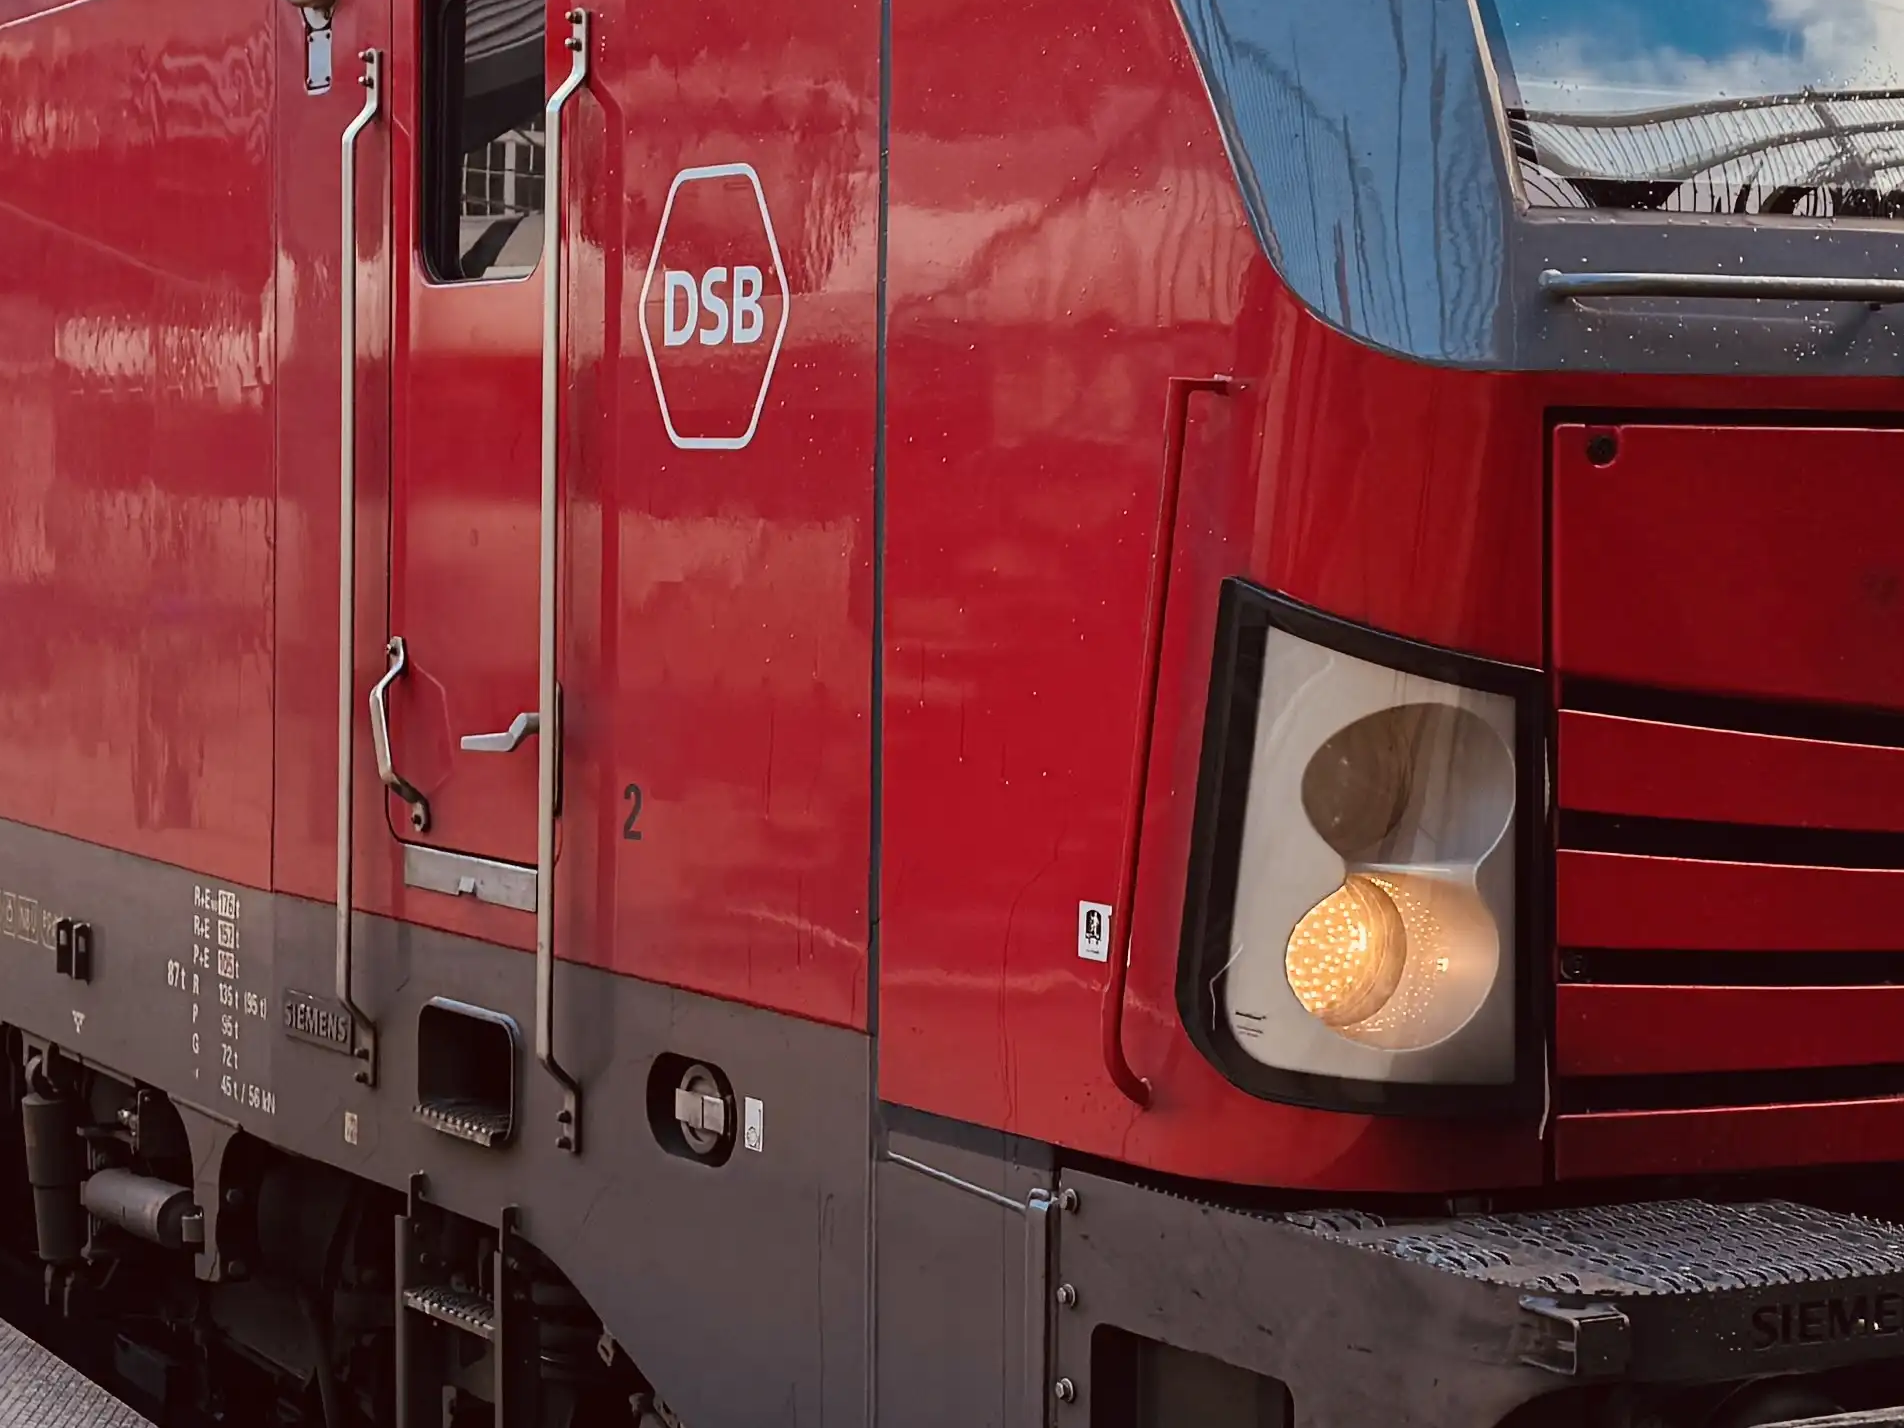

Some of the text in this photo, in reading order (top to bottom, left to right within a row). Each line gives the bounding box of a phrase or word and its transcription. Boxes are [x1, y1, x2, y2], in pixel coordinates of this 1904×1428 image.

[663, 265, 765, 346] DSB
[624, 783, 643, 841] 2
[194, 914, 210, 939] R+E
[193, 943, 210, 968] P+E
[168, 958, 180, 987] 87
[193, 973, 199, 995] R
[193, 1002, 199, 1023] P
[285, 1002, 348, 1044] SIEMENS
[192, 1032, 199, 1054] G
[221, 1043, 232, 1067] 72
